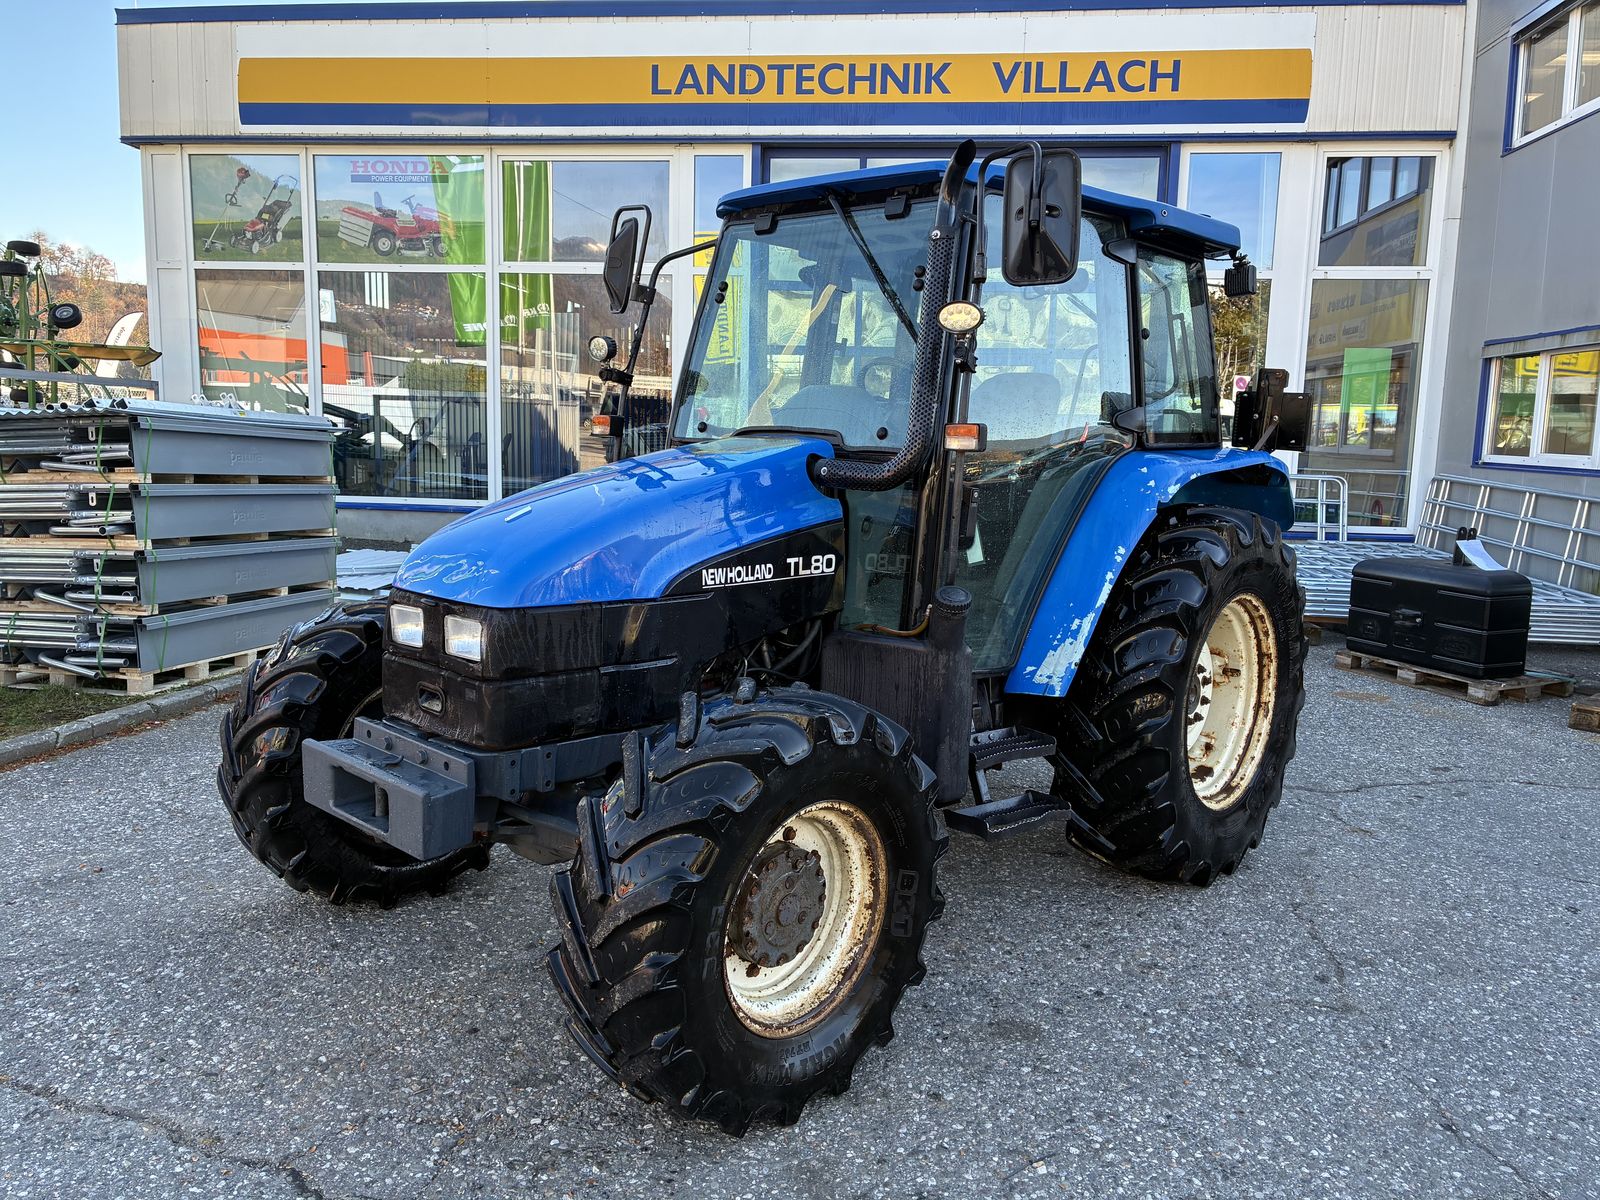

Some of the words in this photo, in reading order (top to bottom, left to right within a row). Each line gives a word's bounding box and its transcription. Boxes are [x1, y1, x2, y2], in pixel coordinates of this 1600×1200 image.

[651, 62, 952, 95] LANDTECHNIK
[992, 59, 1181, 94] VILLACH
[350, 160, 449, 174] HONDA
[394, 175, 429, 183] EQUIPMENT
[702, 568, 726, 586] NEW
[727, 563, 774, 584] HOLLAND
[786, 553, 836, 577] TL80
[889, 869, 919, 937] BKT
